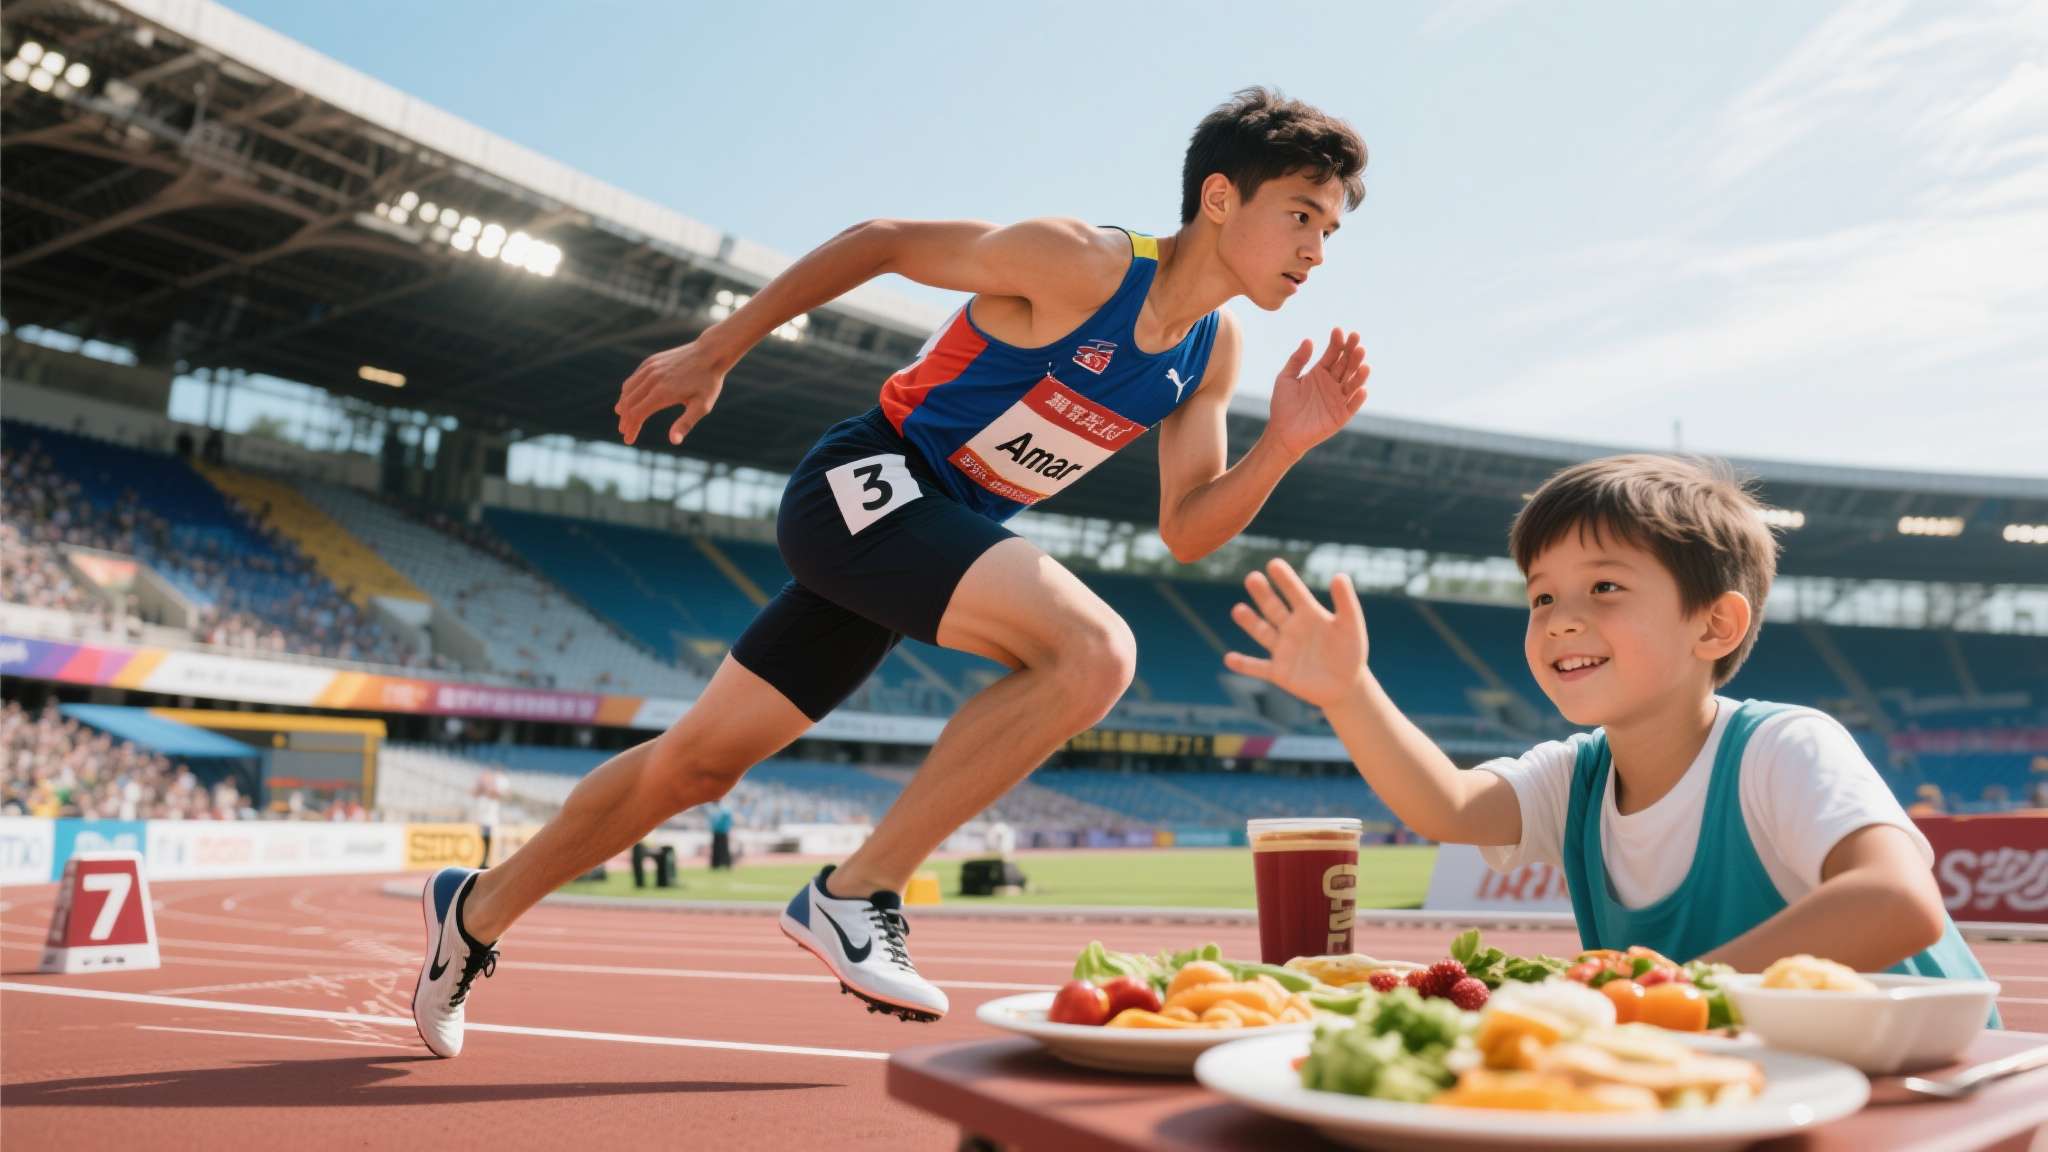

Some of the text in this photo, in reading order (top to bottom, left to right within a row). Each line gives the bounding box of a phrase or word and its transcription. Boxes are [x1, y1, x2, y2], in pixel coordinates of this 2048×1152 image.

[995, 432, 1084, 481] Amar
[853, 463, 893, 511] 3
[83, 872, 132, 941] 7
